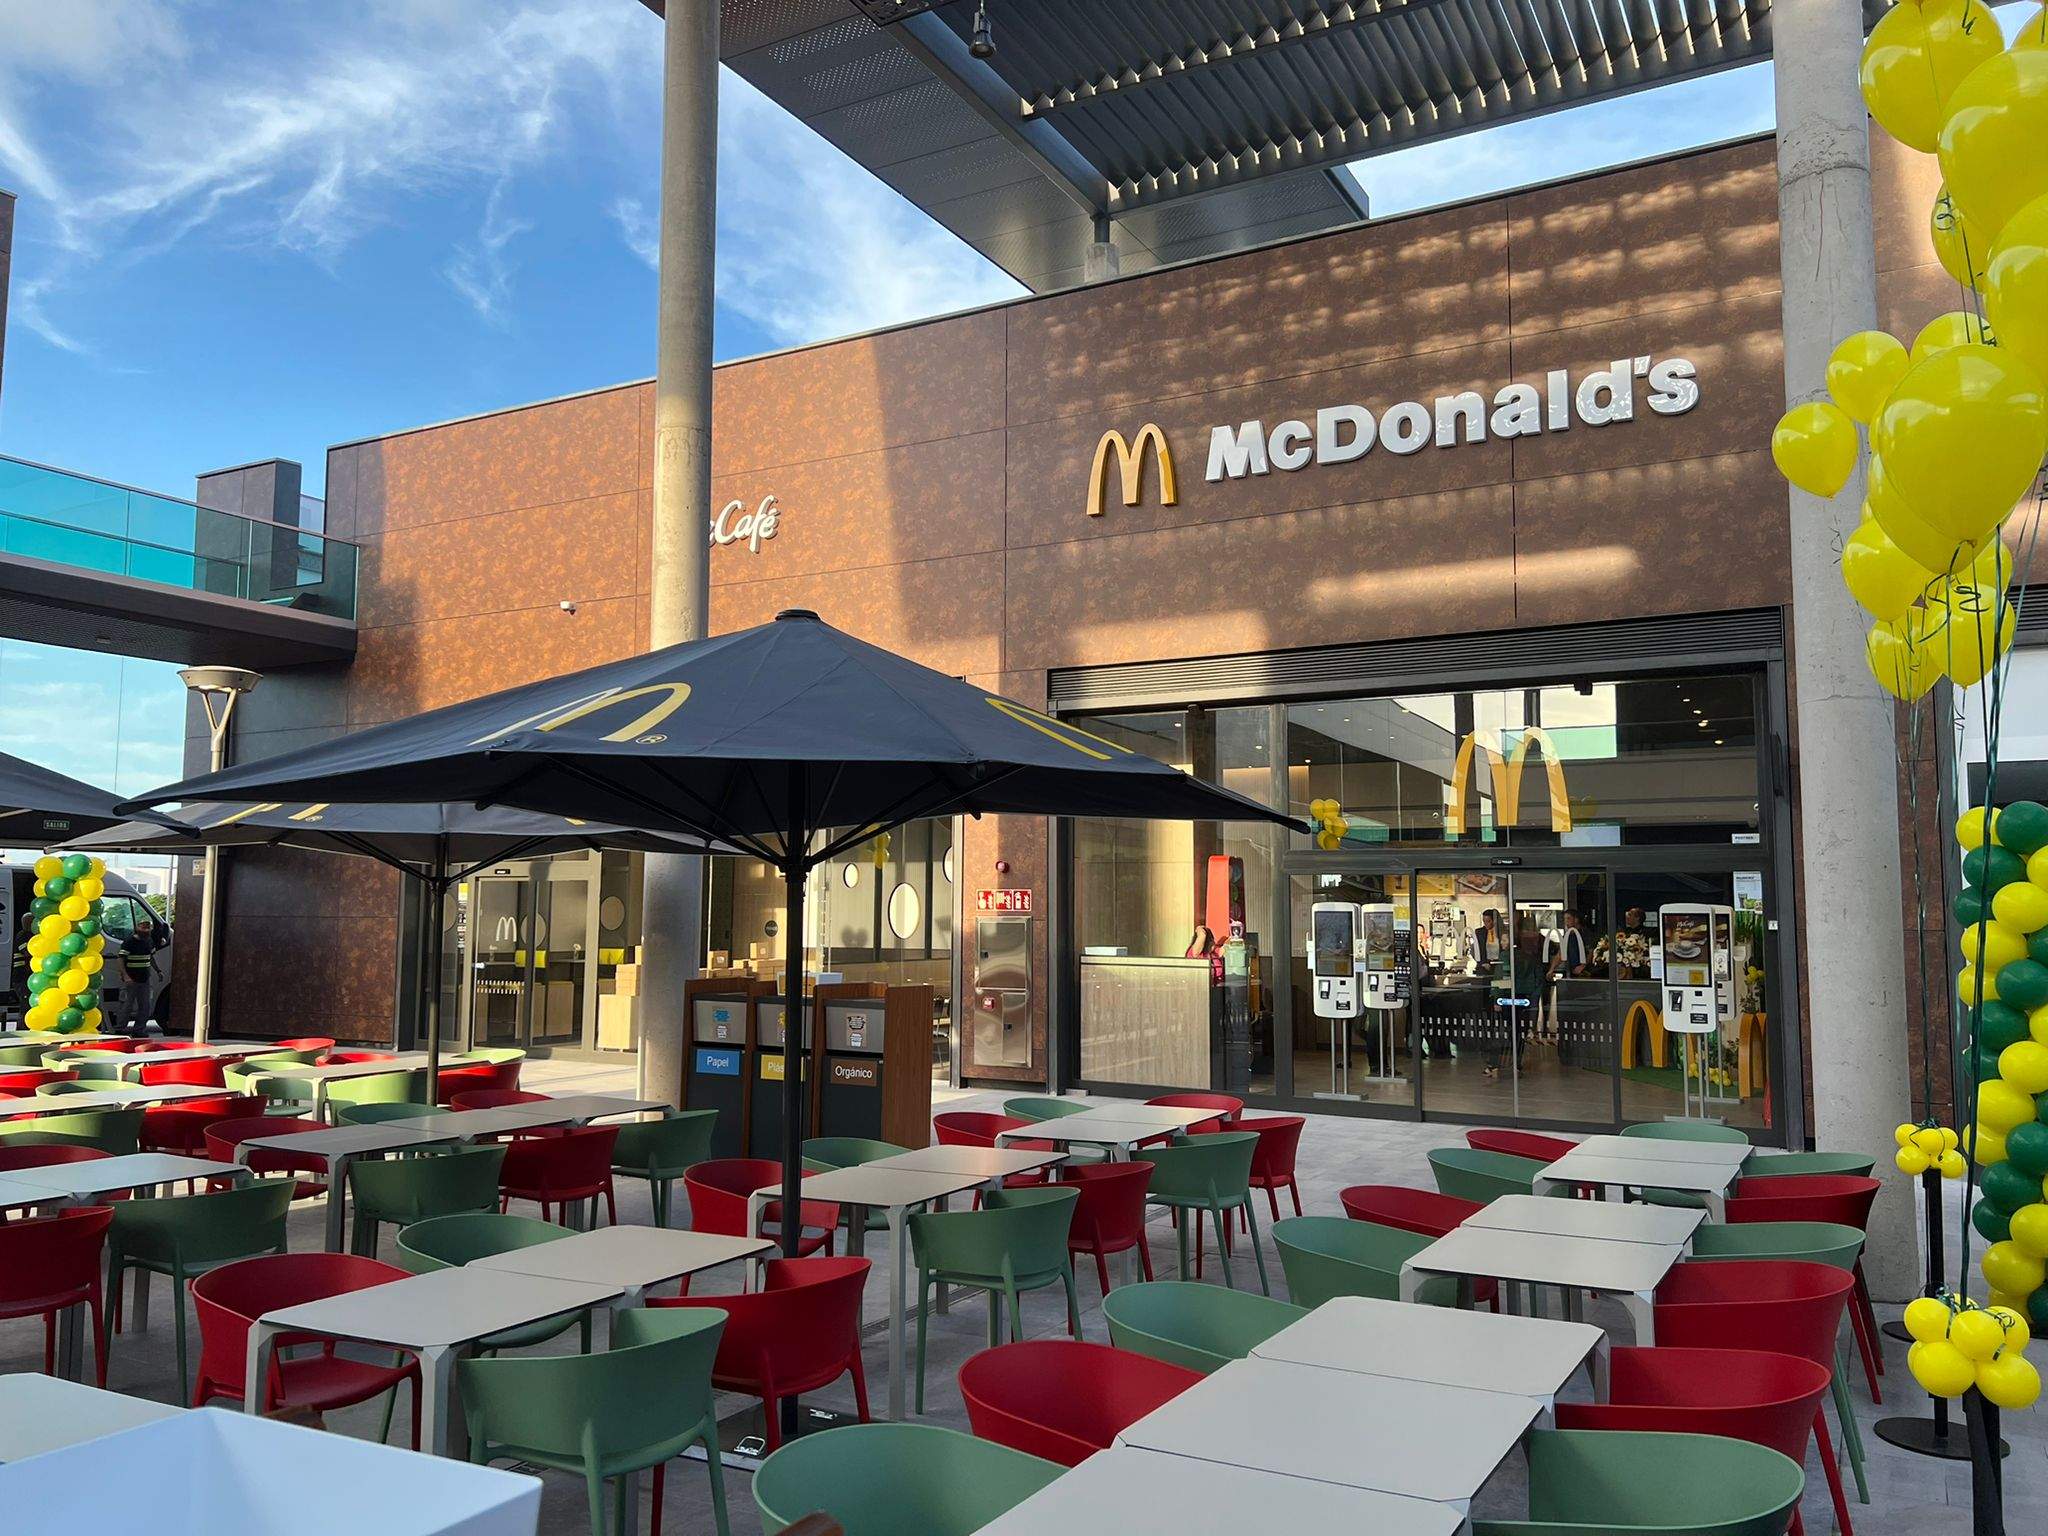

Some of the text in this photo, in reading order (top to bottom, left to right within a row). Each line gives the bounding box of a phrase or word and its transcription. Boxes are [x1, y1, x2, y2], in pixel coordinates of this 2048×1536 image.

[1205, 355, 1699, 483] McDonald's
[709, 495, 779, 552] Café
[706, 1056, 729, 1068] Papel
[767, 1062, 785, 1073] Plás
[835, 1065, 873, 1079] Orgánico
